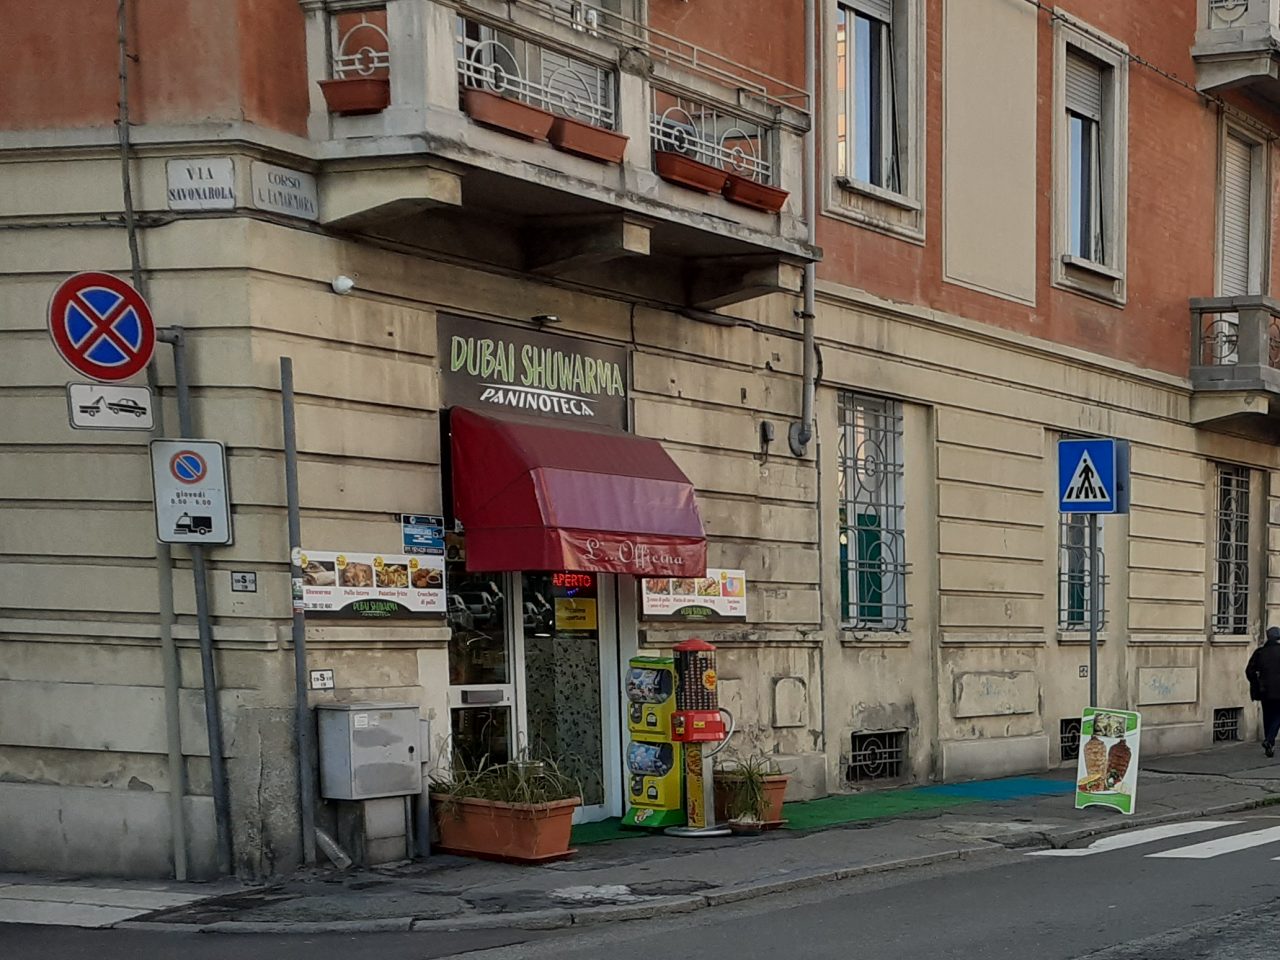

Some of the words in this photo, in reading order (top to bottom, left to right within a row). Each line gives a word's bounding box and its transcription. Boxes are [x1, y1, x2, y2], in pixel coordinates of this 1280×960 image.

[187, 167, 214, 180] VIA
[268, 171, 301, 189] CORSO
[169, 186, 234, 201] SAVONAROLA
[451, 335, 515, 383] DUBAI
[521, 344, 625, 397] SHUWARMA
[479, 388, 595, 417] PANINOTECA
[241, 575, 247, 584] S
[552, 573, 592, 587] APERTO
[319, 673, 326, 682] S
